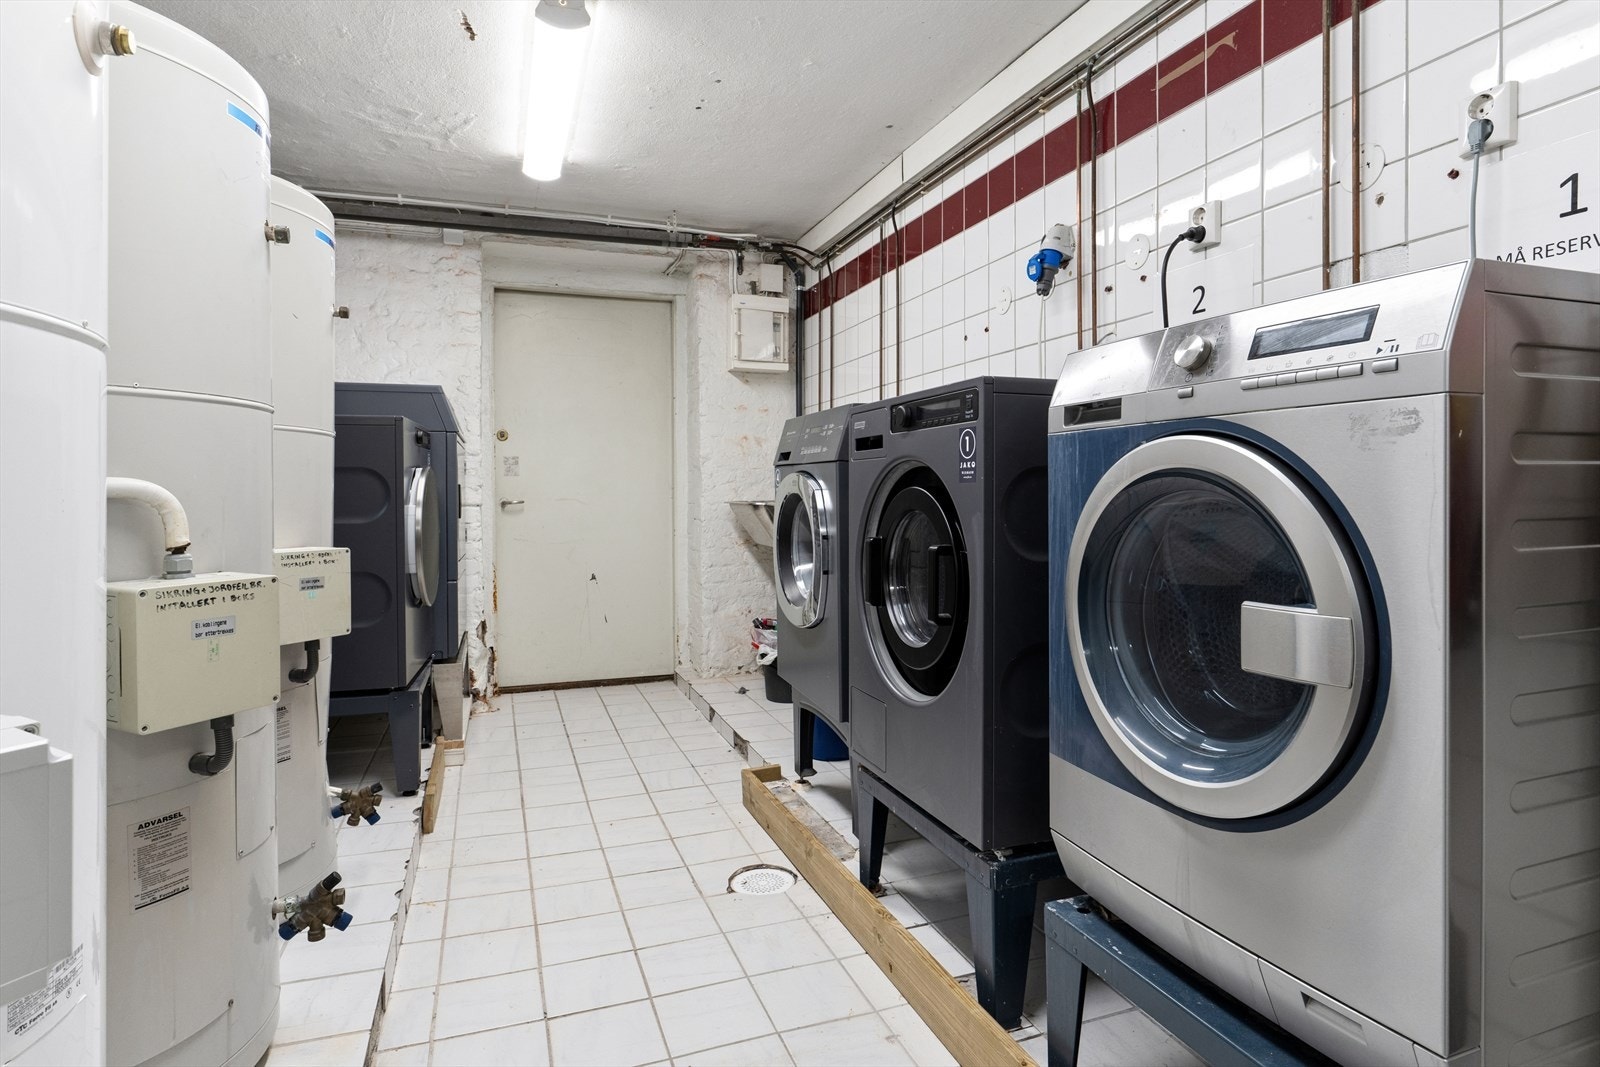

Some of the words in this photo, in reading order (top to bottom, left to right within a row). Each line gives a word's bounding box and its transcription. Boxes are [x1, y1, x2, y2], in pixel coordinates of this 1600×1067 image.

[1559, 173, 1588, 218] 1
[1192, 285, 1206, 315] 2
[959, 461, 976, 469] JAKO
[137, 811, 183, 831] ADVARSEL
[14, 1022, 28, 1035] CTC
